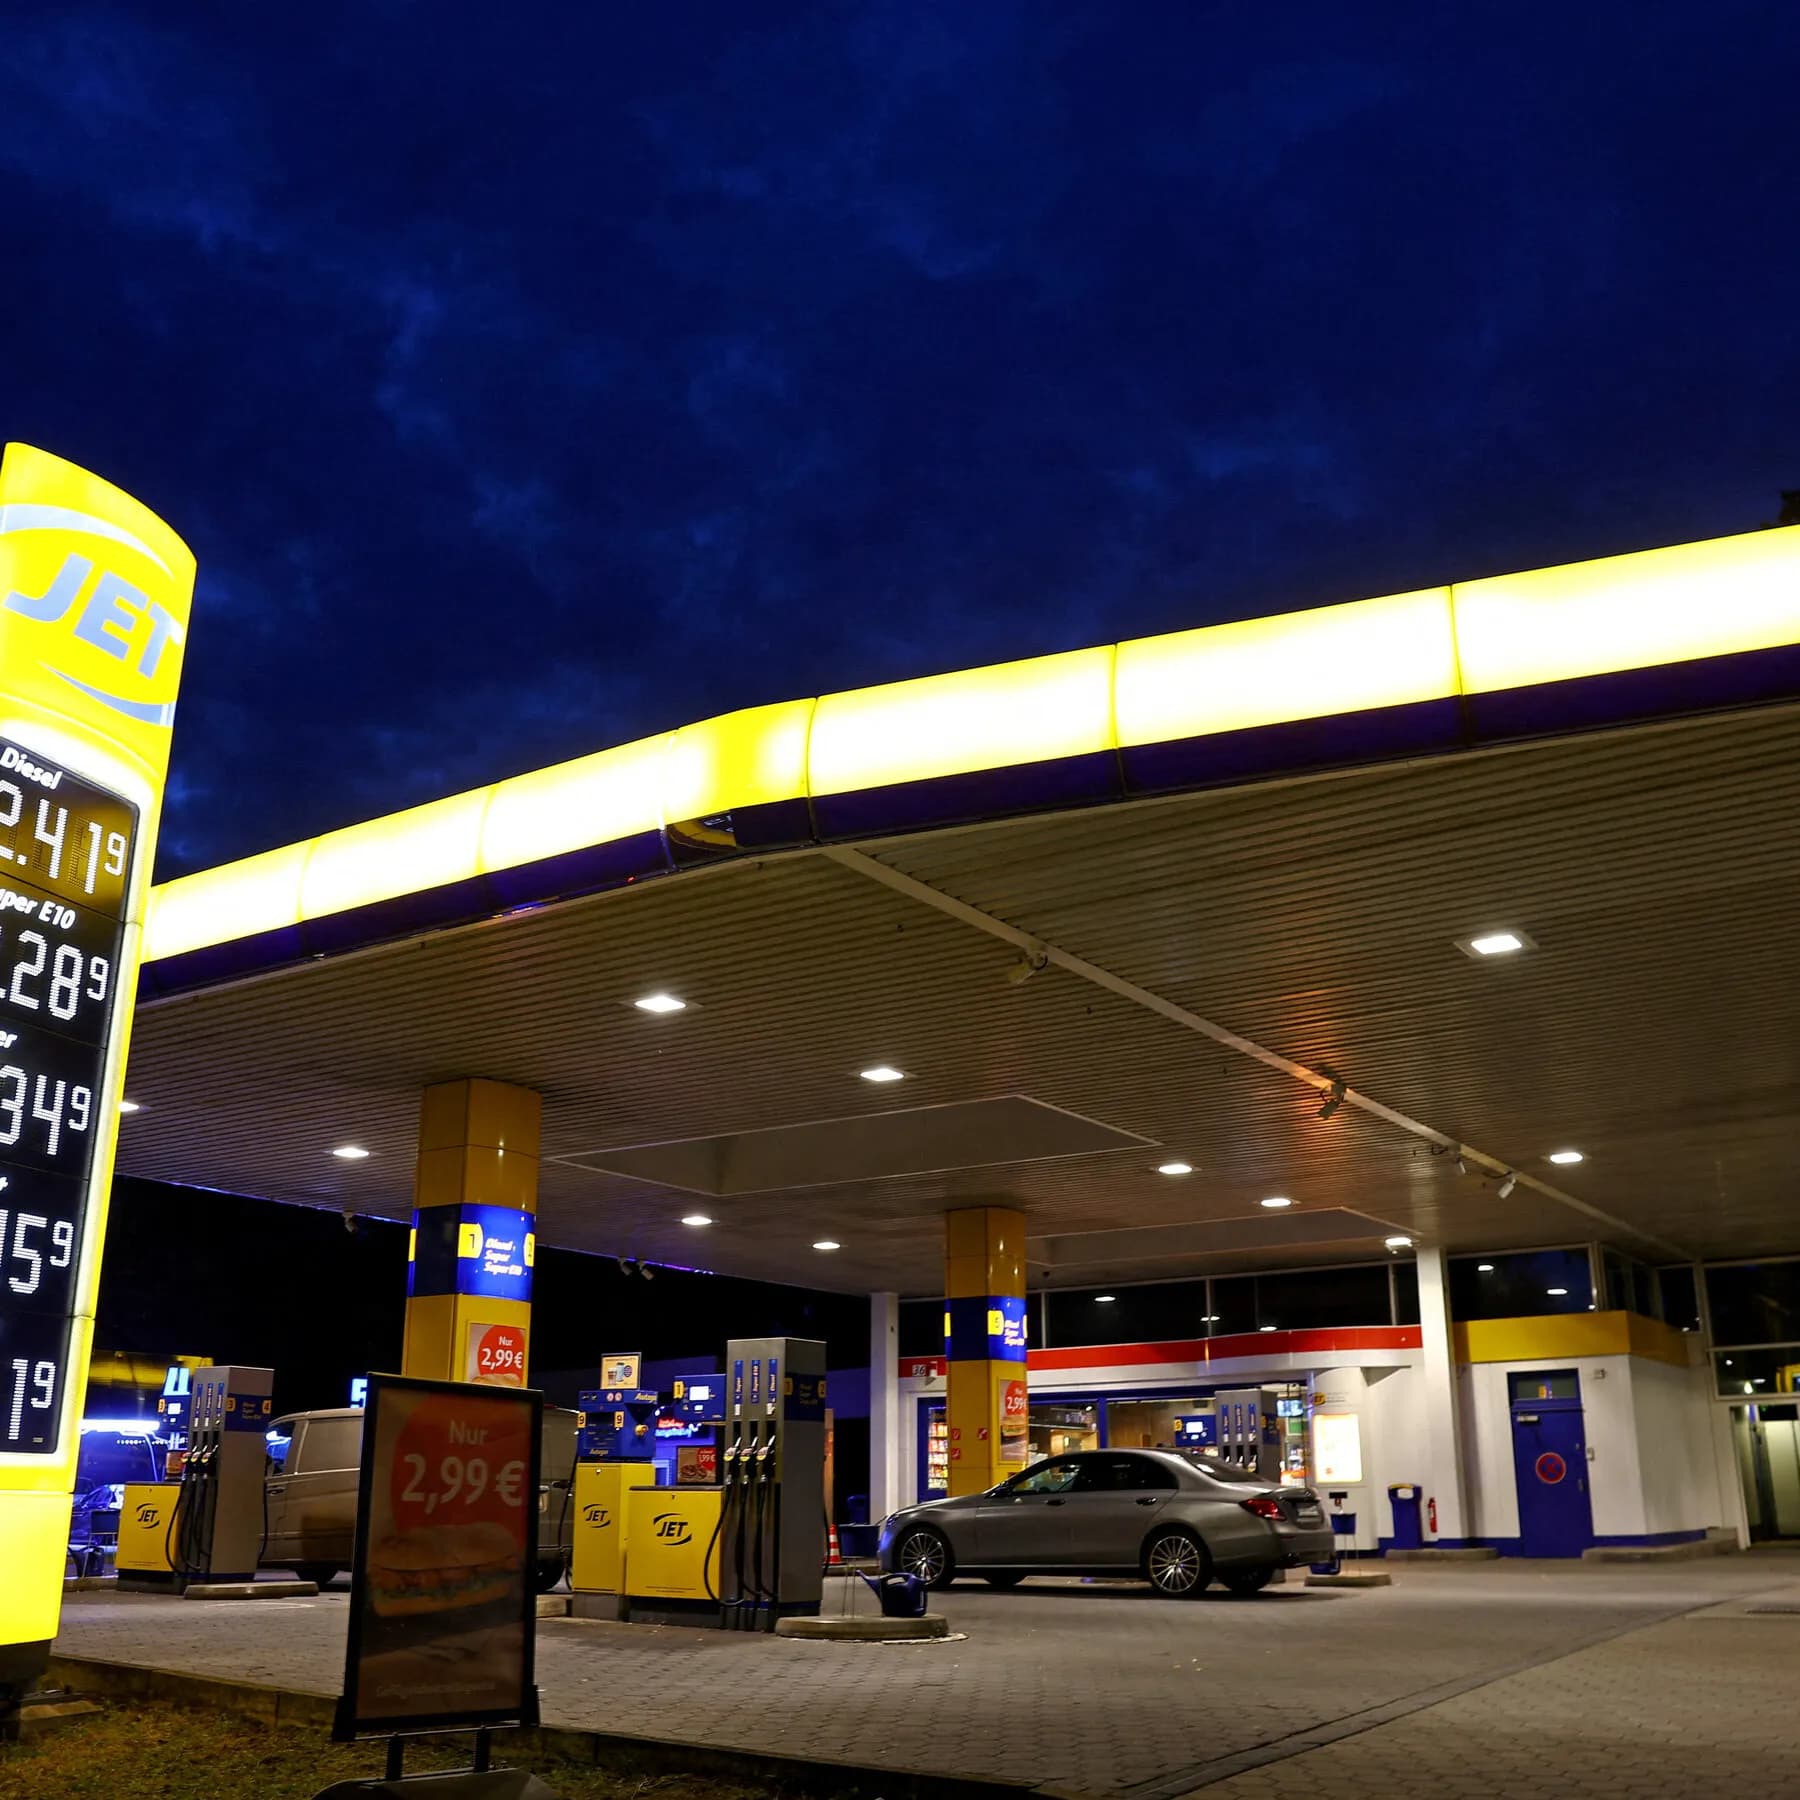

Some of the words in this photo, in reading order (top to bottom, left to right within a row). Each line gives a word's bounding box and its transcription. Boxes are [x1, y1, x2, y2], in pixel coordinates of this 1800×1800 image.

[3, 551, 184, 679] JET
[0, 746, 63, 790] Diesel
[38, 900, 76, 929] E10
[499, 1336, 512, 1346] Nur
[448, 1420, 489, 1446] Nur
[137, 1509, 159, 1523] JET
[584, 1510, 609, 1523] JET
[656, 1521, 689, 1538] JET
